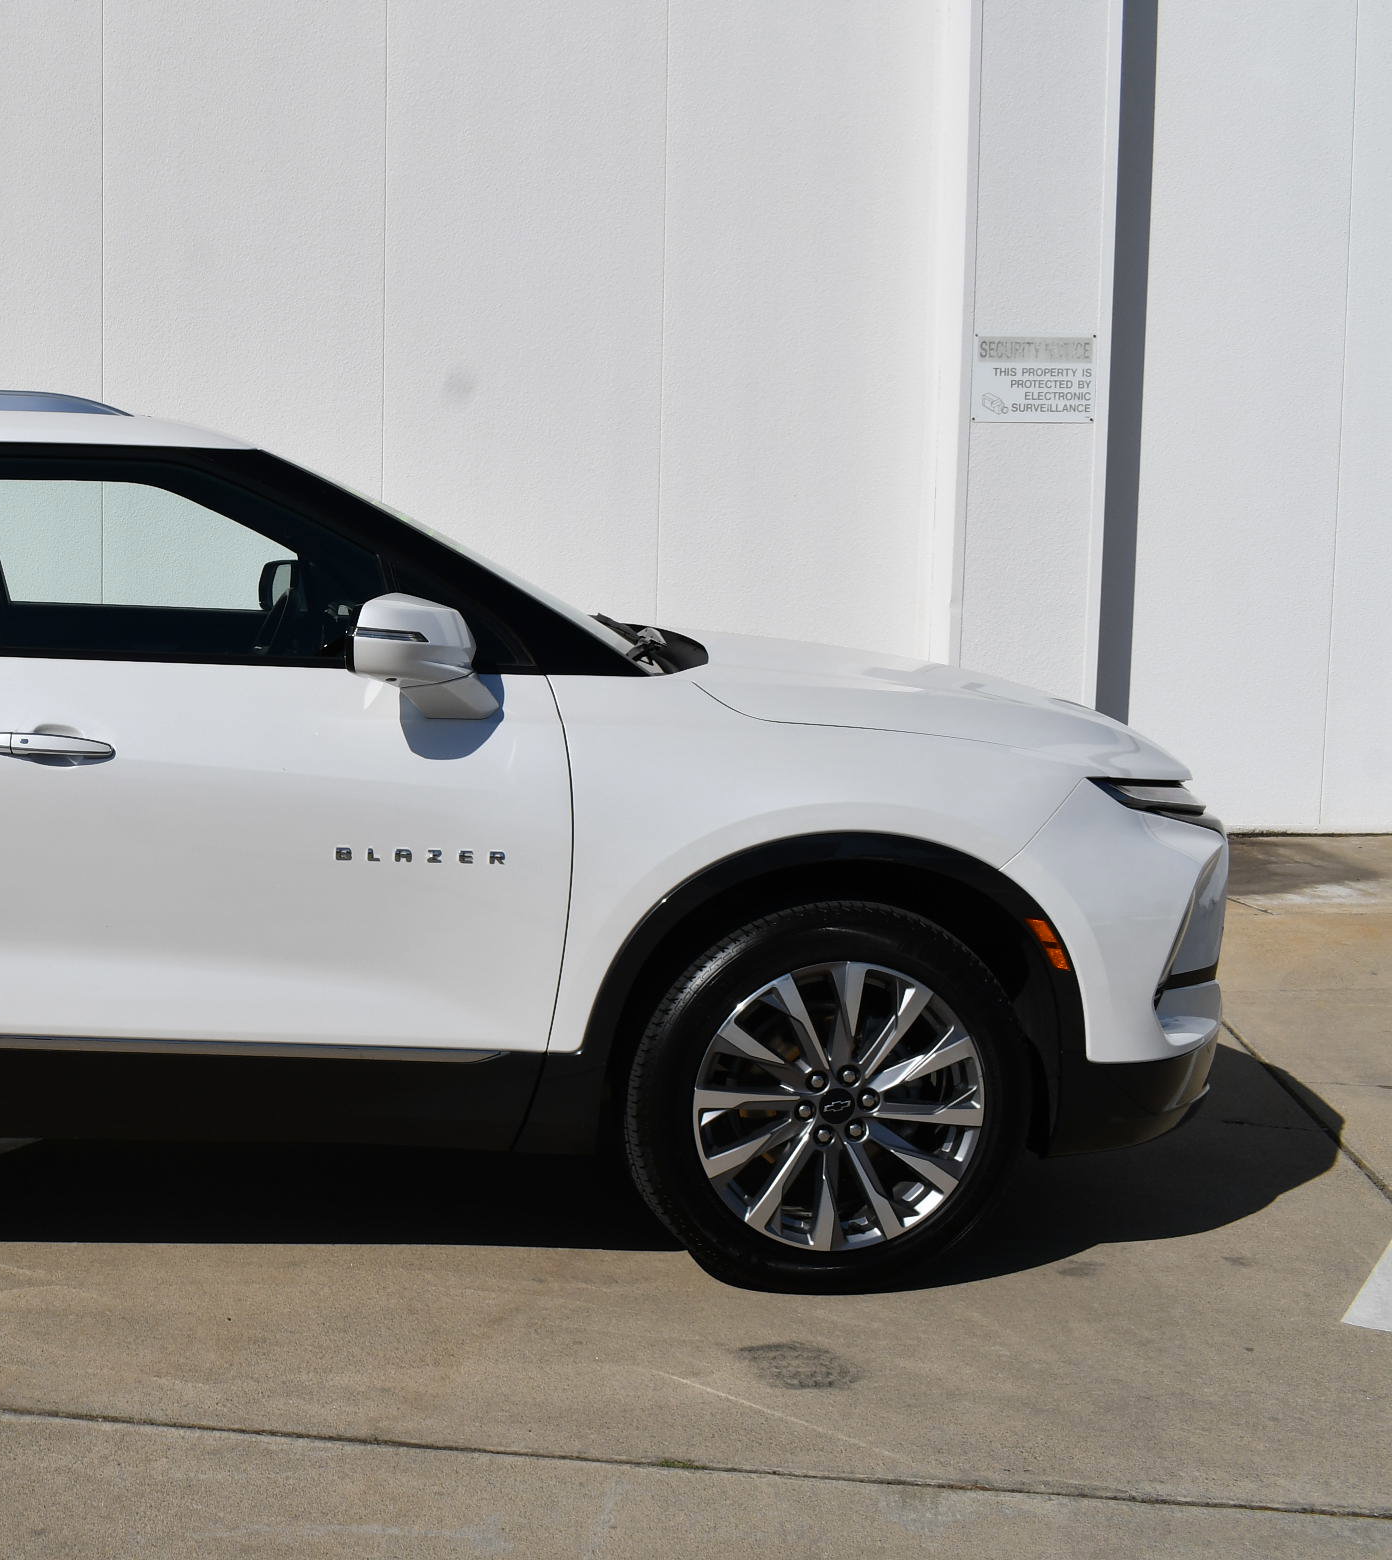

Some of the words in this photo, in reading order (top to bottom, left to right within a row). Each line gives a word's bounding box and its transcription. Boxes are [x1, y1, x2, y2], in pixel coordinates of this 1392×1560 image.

[979, 340, 1041, 359] SECURITY
[1044, 341, 1091, 359] NTCE
[993, 367, 1017, 377] THIS
[1021, 367, 1078, 377] PROPERTY
[1082, 368, 1092, 377] IS
[1010, 379, 1074, 389] PROTECTED
[1077, 380, 1092, 389] BY
[1024, 391, 1092, 401] ELECTRONIC
[1010, 402, 1092, 413] SURVEILLANCE
[335, 846, 507, 866] BLAZER
